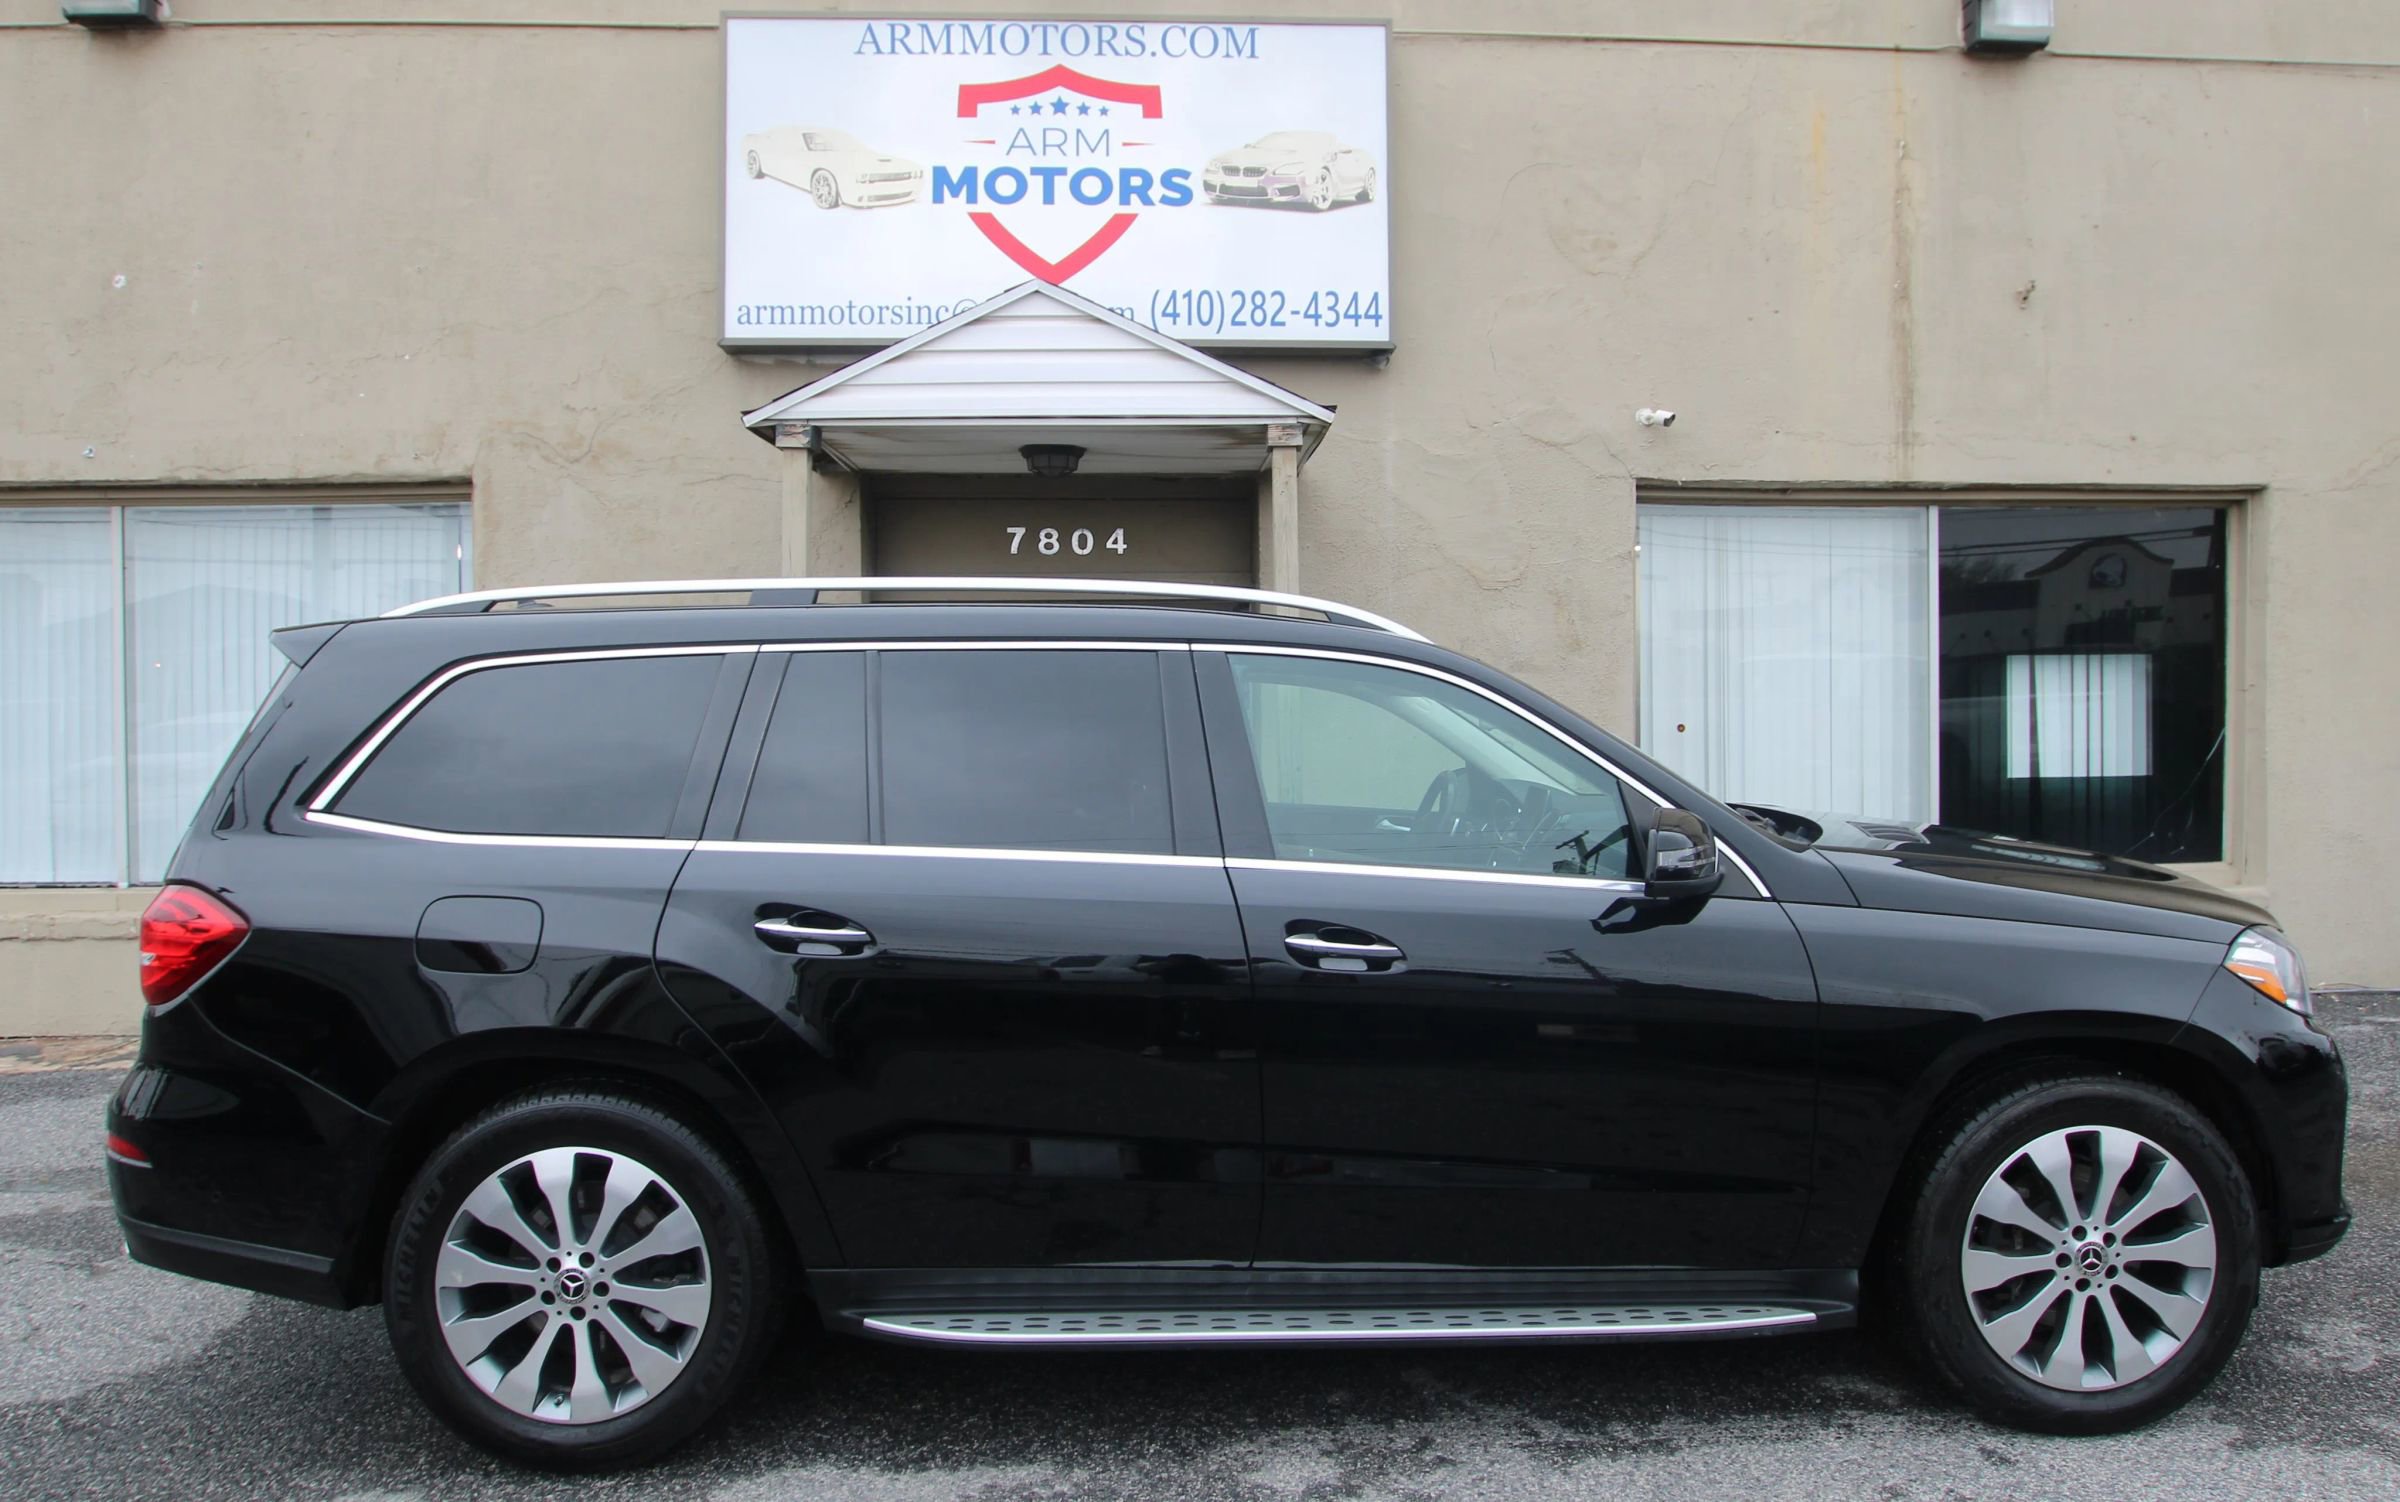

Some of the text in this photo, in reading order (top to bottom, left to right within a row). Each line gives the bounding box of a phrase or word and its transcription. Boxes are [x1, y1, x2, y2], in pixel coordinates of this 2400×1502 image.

[854, 22, 1260, 59] ARMMOTORS.COM
[1006, 127, 1110, 157] ARM
[932, 165, 1194, 208] MOTORS
[1151, 288, 1384, 334] (410)282-4344
[1006, 526, 1128, 555] 7804
